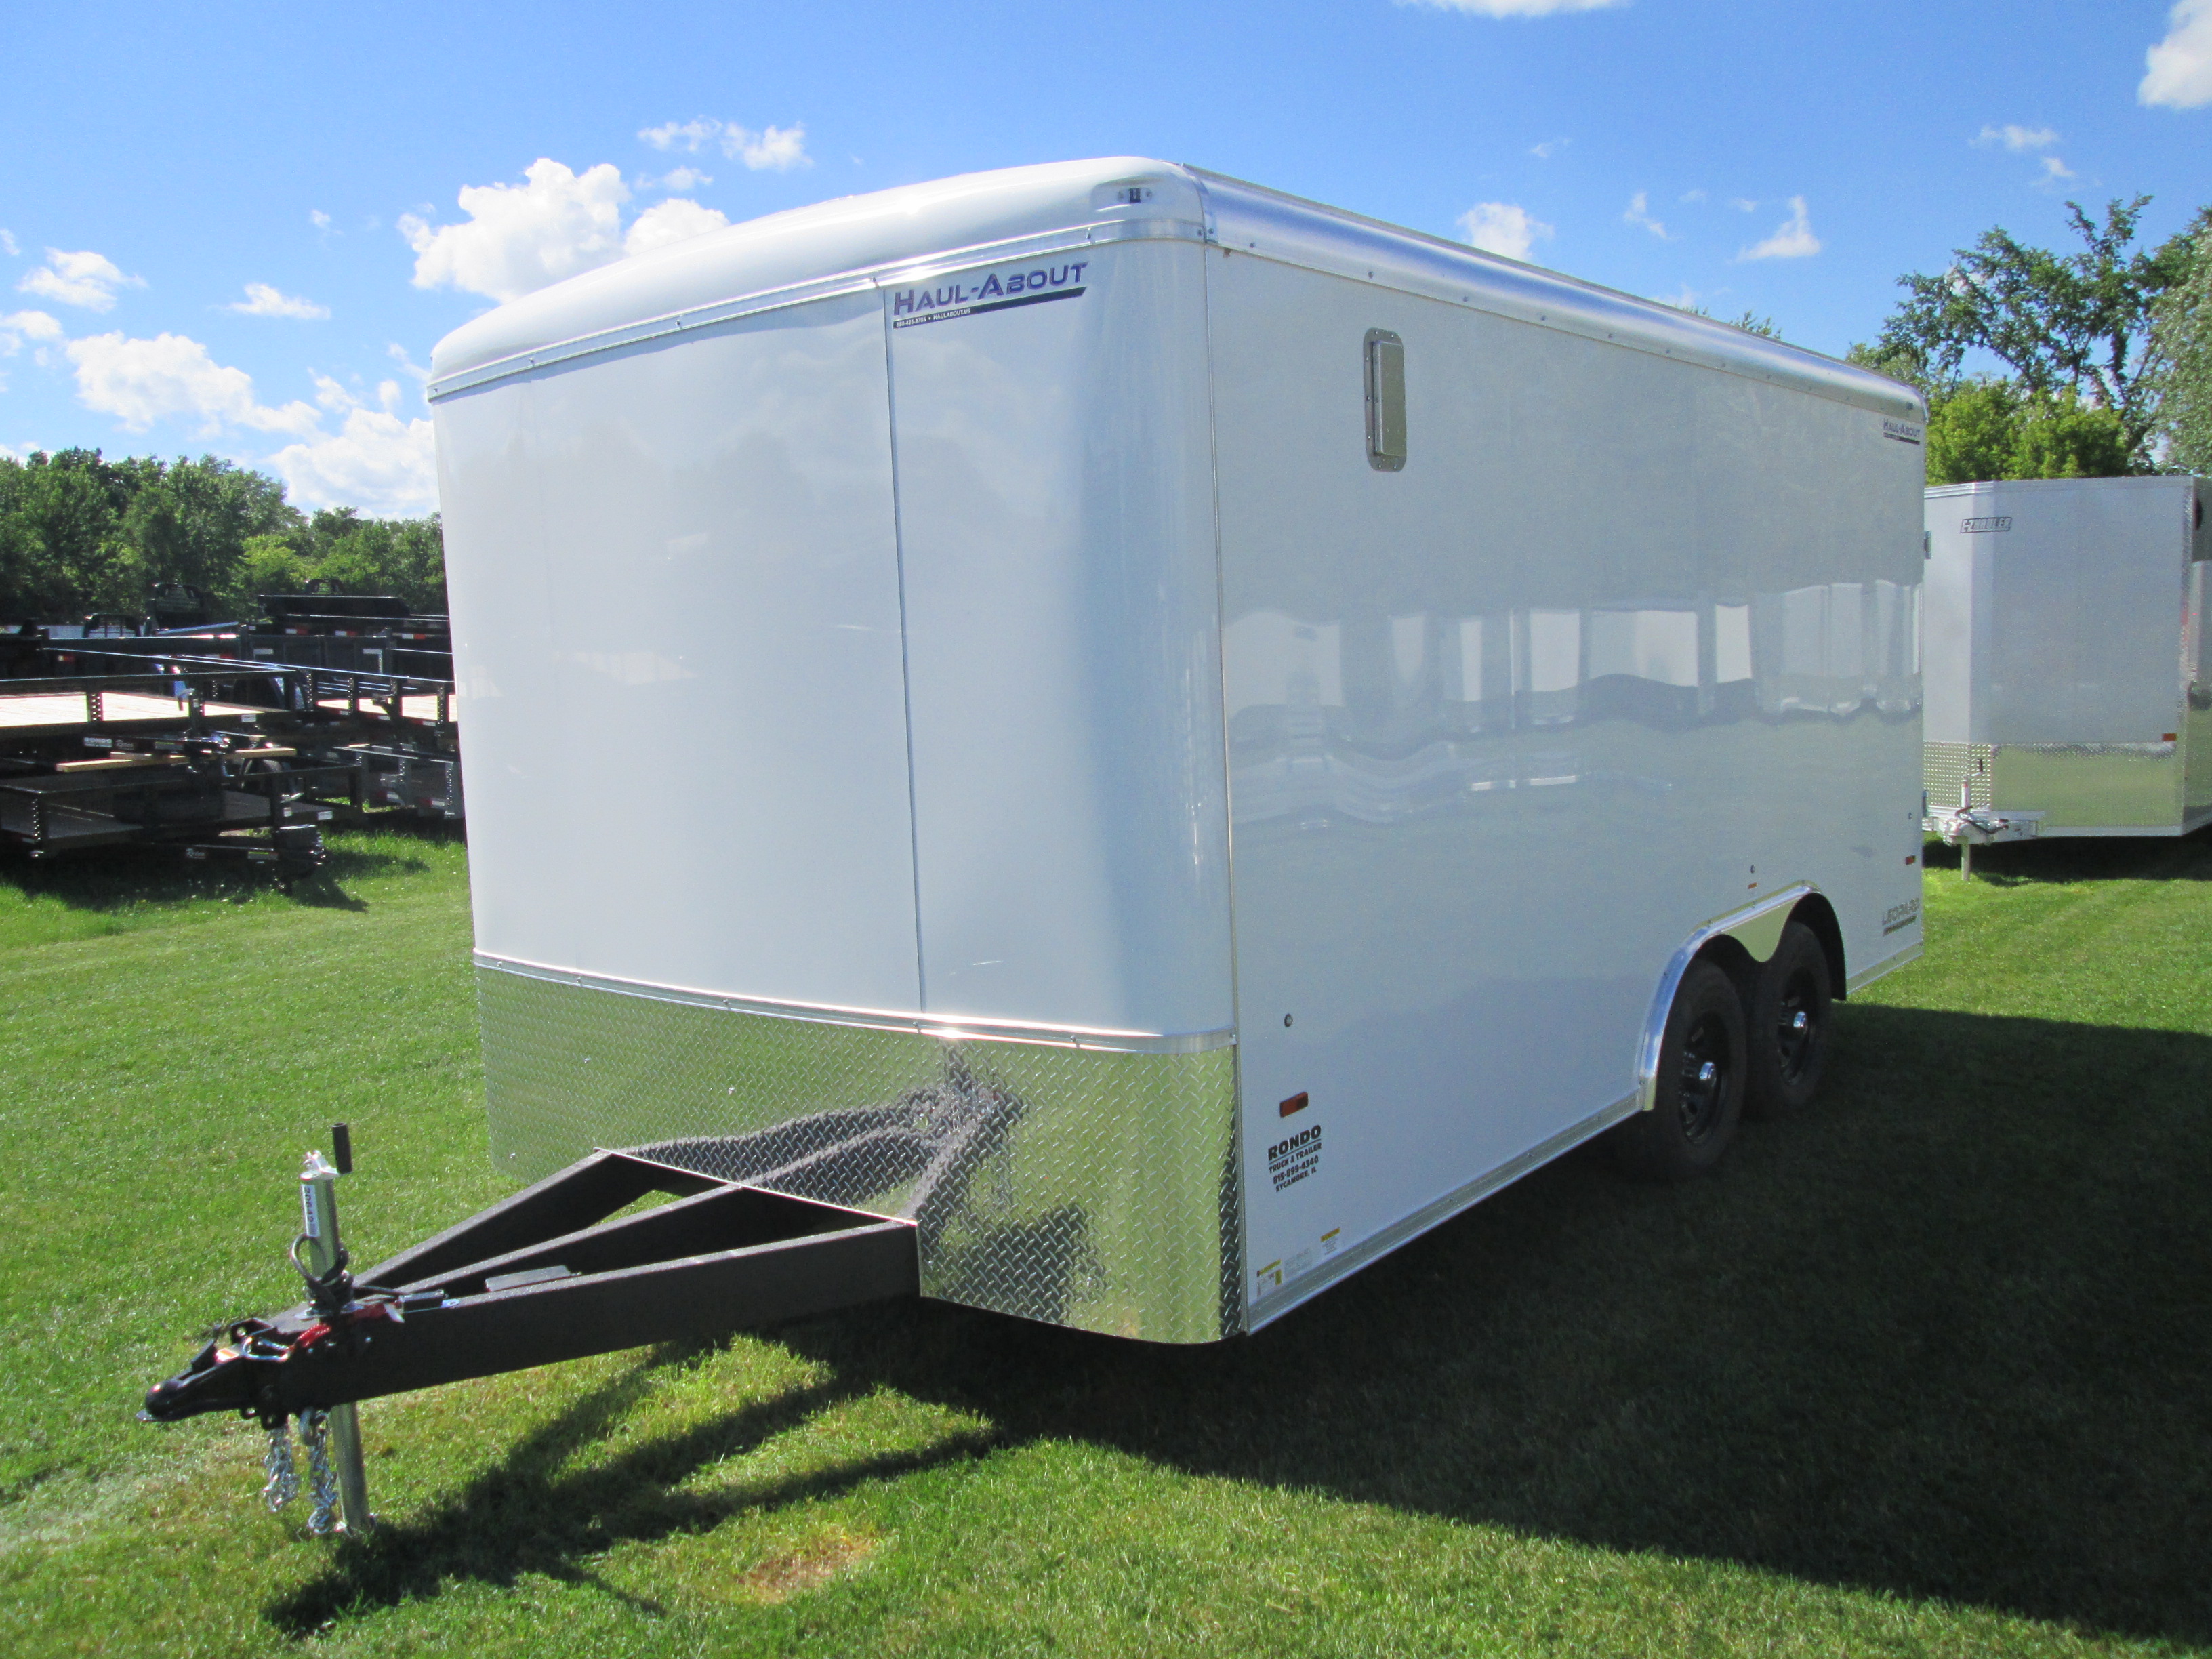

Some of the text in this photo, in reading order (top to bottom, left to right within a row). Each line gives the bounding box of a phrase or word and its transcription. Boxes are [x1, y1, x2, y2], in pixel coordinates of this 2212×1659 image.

[893, 262, 1088, 316] HAUL-ABOUT
[1268, 1124, 1321, 1161] RONDO
[1269, 1158, 1289, 1174] TRUCK
[1296, 1142, 1322, 1160] TRAILER
